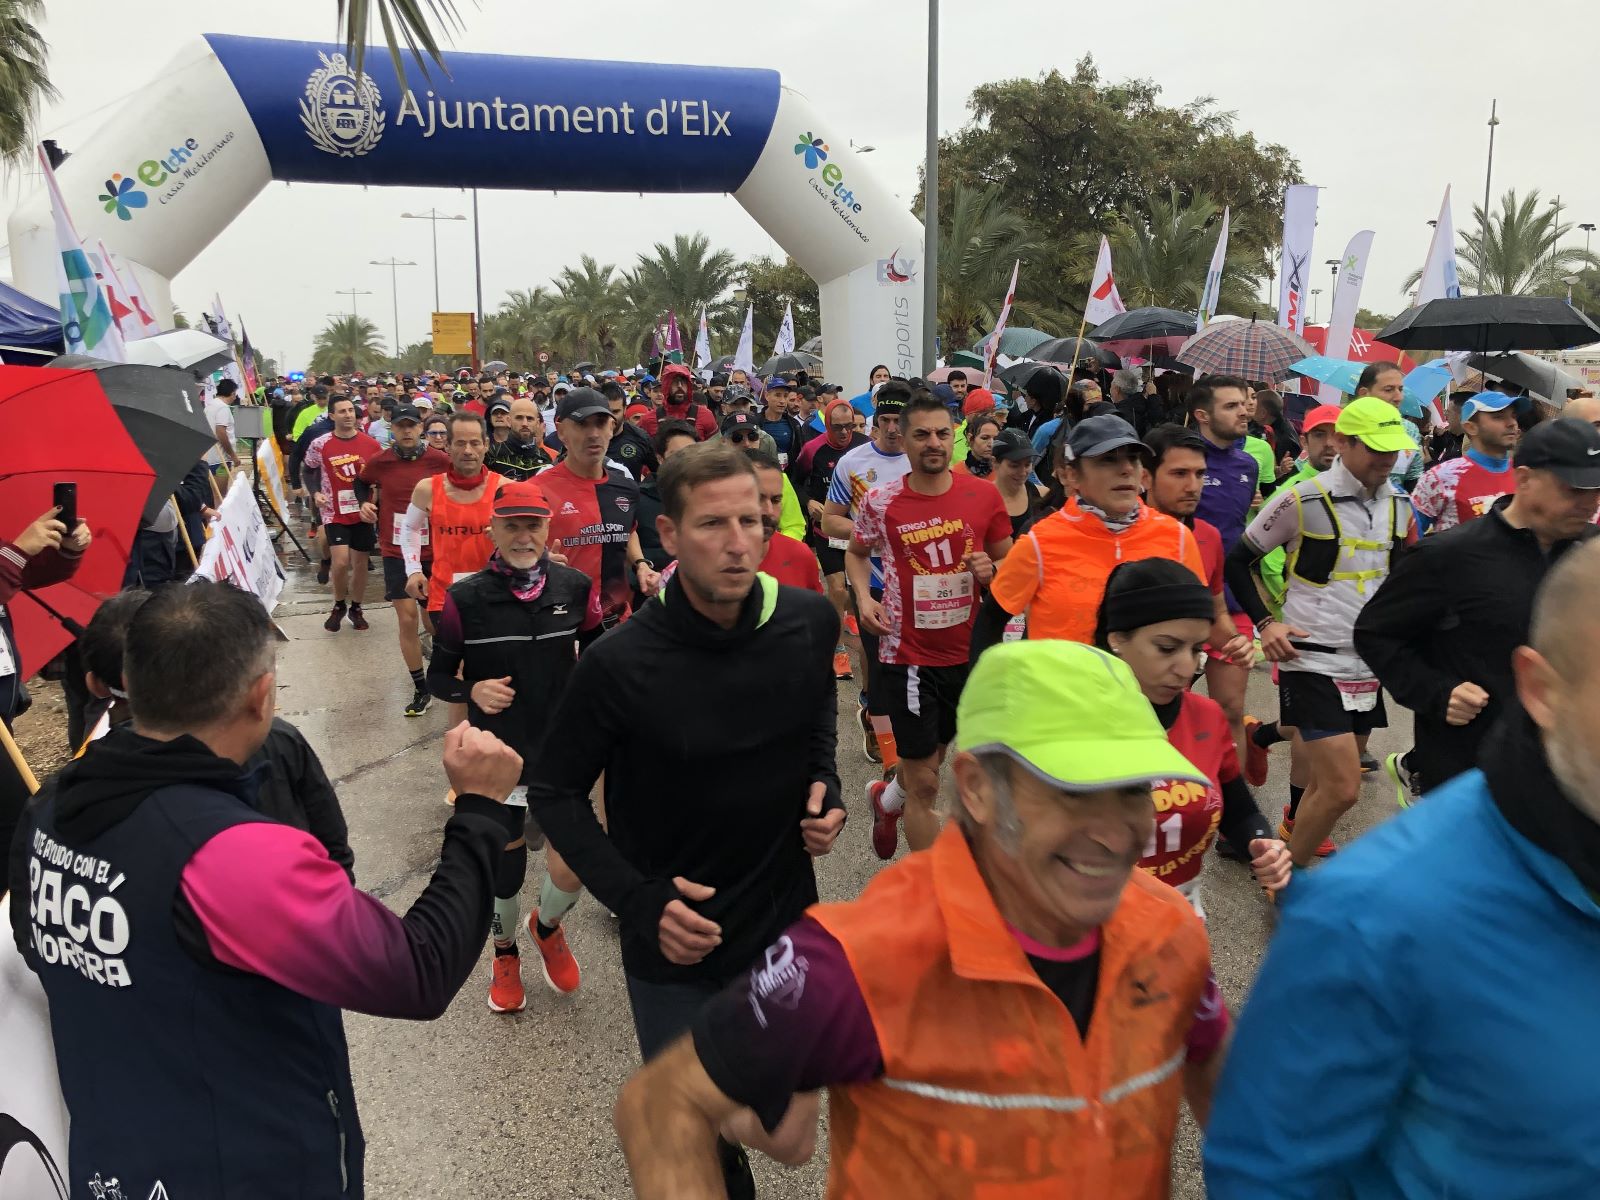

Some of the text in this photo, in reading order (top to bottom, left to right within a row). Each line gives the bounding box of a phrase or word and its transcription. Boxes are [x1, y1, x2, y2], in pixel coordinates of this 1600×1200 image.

[396, 89, 732, 138] Ajuntament d'Elx
[137, 137, 199, 187] elche
[823, 163, 862, 213] elche
[580, 522, 625, 535] NATURA SPORT
[896, 516, 942, 534] TENGO UN
[901, 518, 964, 546] SUBIDÓN
[563, 537, 580, 547] CLUB
[924, 538, 954, 568] 11
[930, 599, 960, 611] XanAri
[937, 589, 953, 598] 261
[43, 838, 73, 871] AYUDO
[73, 854, 96, 880] CON
[95, 860, 112, 884] EL
